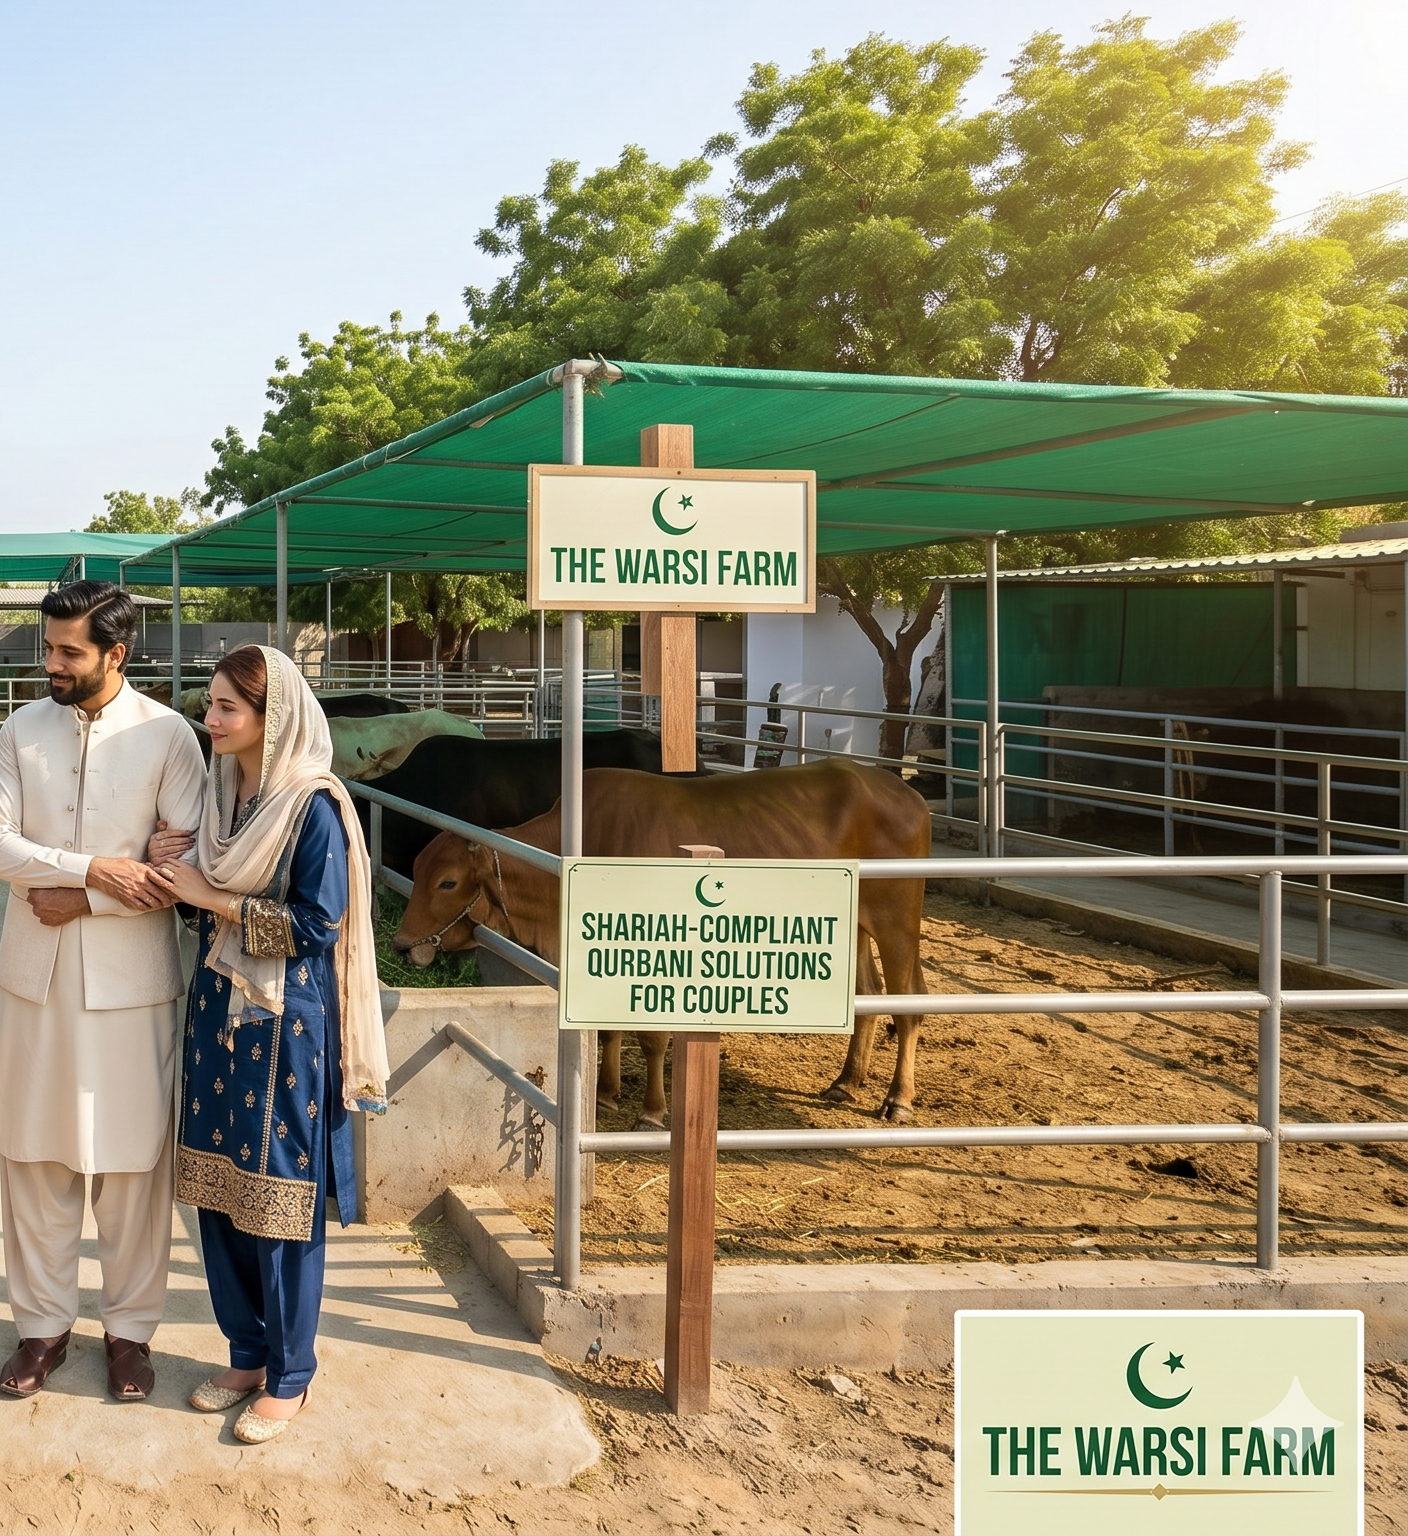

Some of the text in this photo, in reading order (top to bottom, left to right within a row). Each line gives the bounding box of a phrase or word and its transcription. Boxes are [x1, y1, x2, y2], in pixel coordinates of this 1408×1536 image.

[550, 547, 797, 587] THE WARSI FARM
[581, 912, 838, 945] SHARIAH-COMPLIANT
[587, 947, 832, 981] QURBANI SOLUTIONS
[630, 984, 789, 1015] FOR COUPLES
